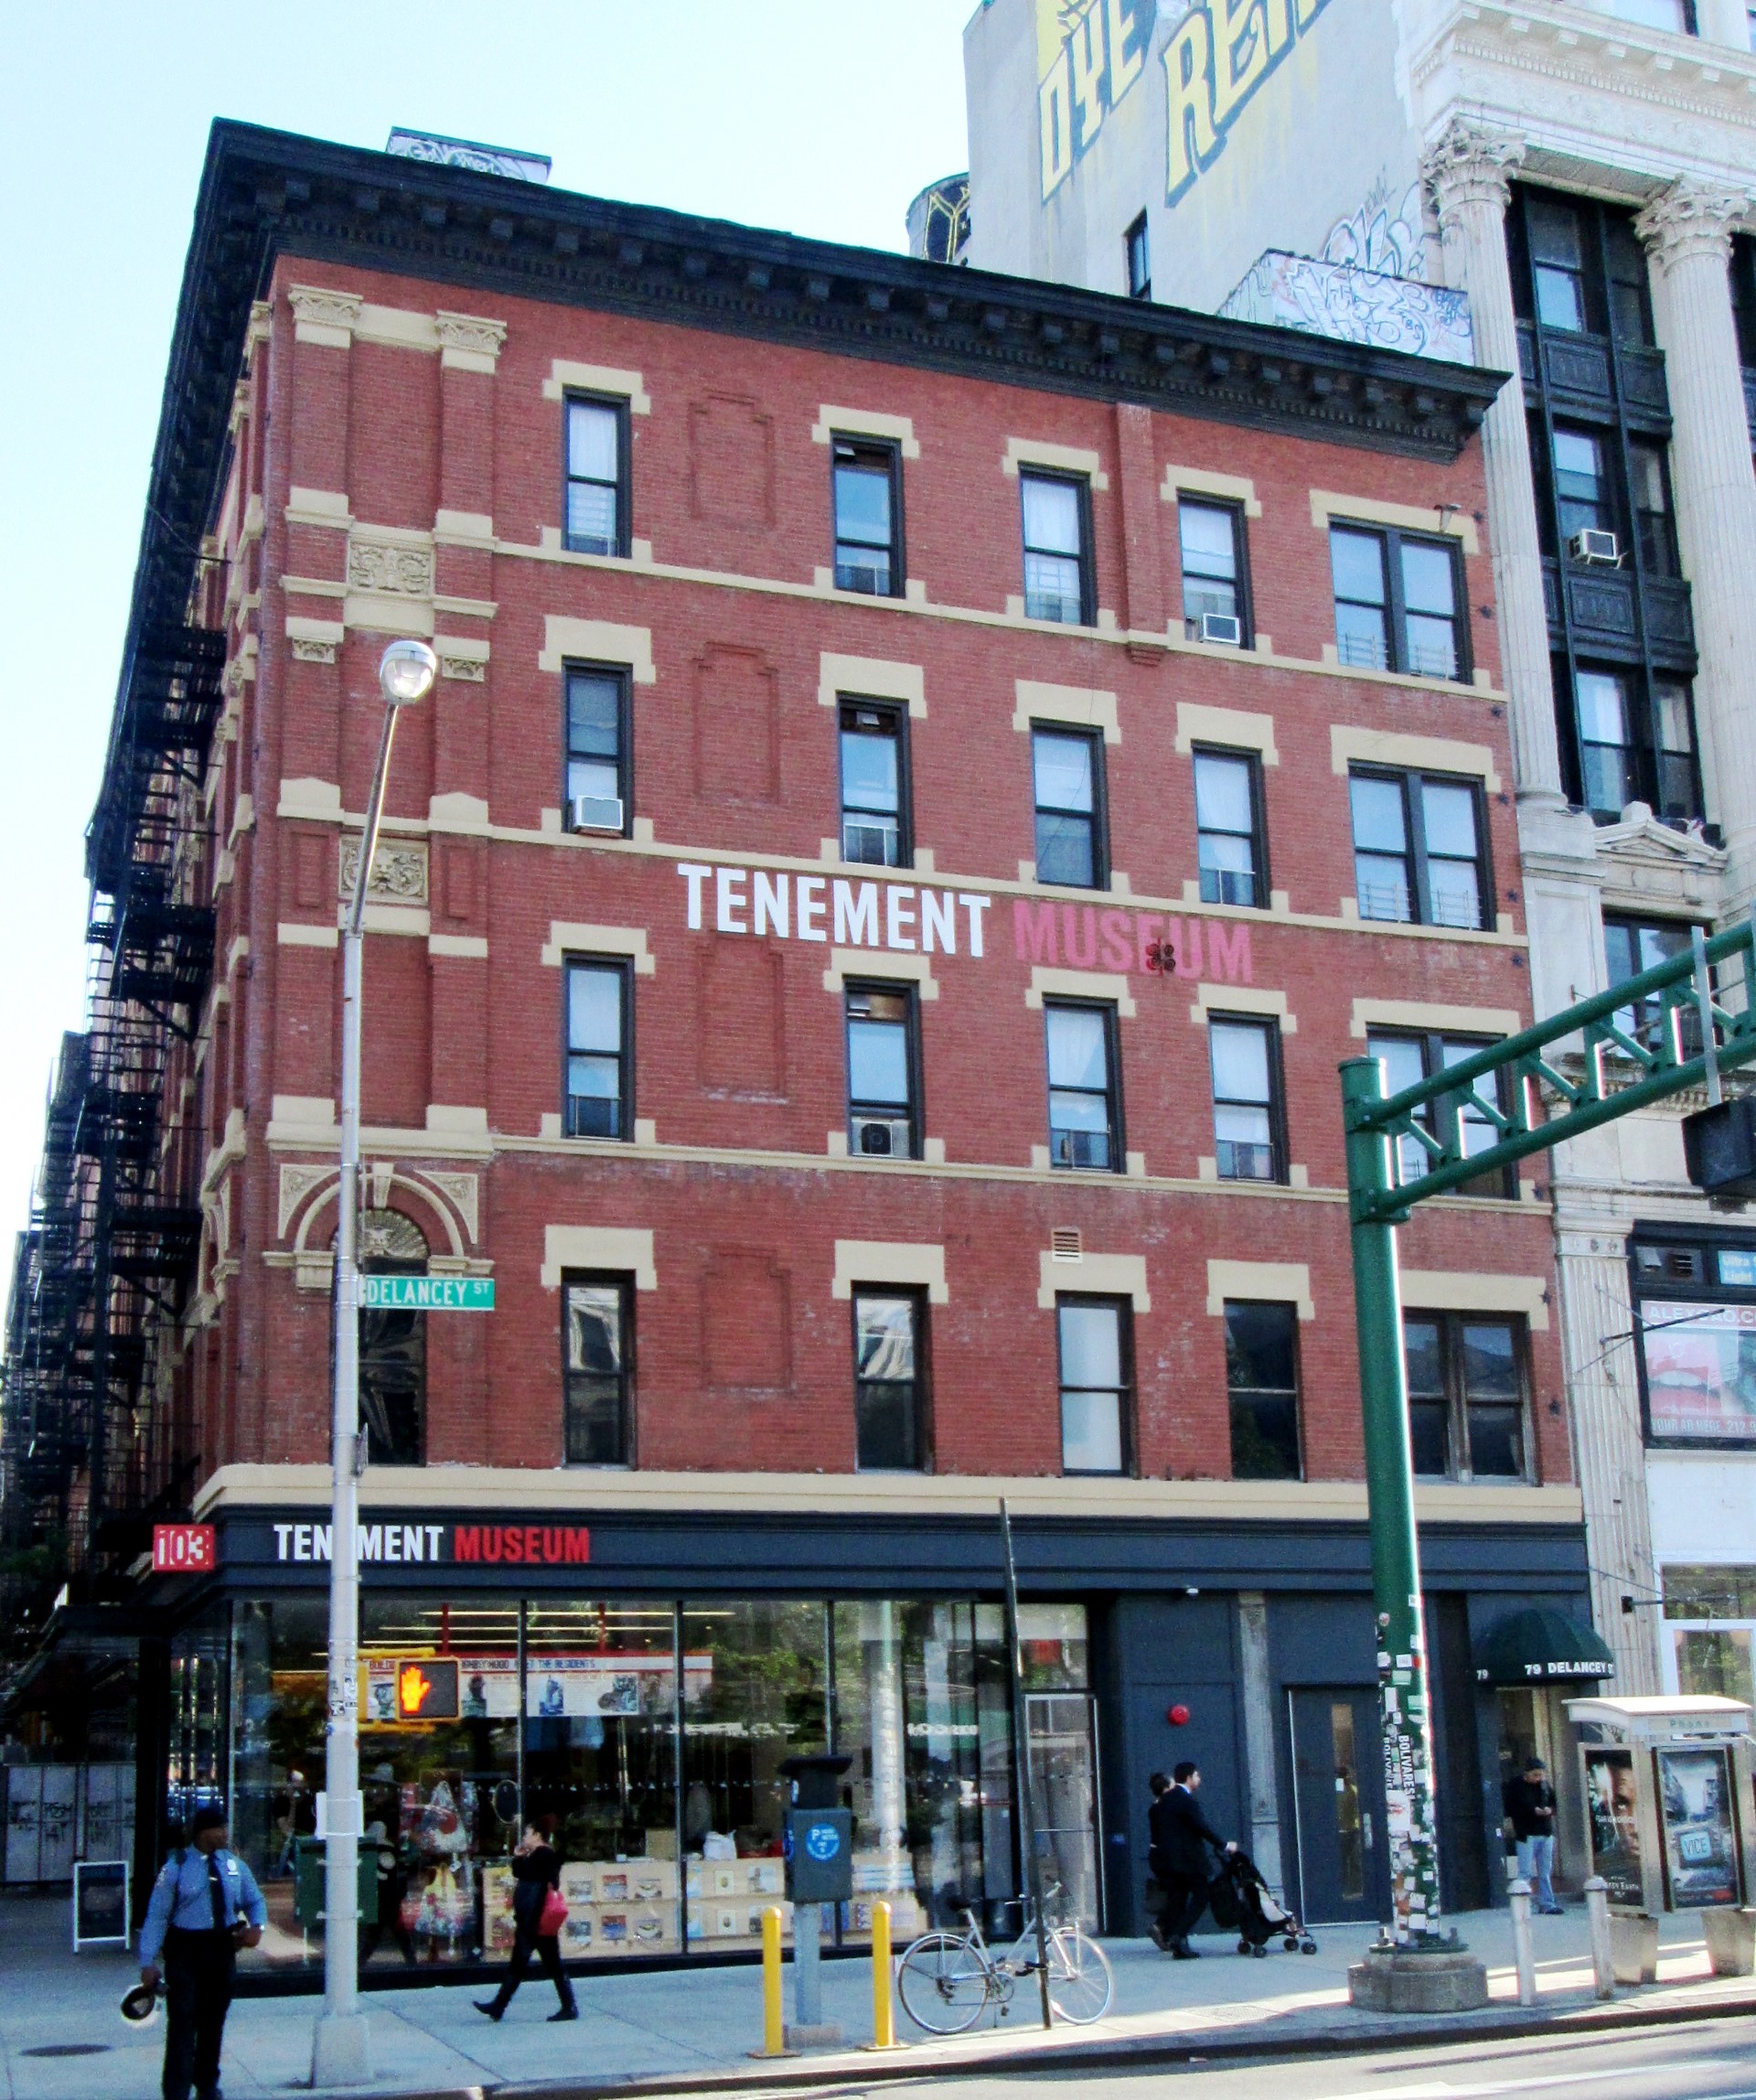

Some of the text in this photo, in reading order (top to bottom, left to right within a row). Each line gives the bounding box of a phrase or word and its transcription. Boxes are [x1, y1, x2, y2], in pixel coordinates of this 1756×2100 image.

[677, 862, 1254, 983] TENEMENT MUSEUM
[367, 1280, 490, 1305] DELANCEY ST
[158, 1529, 211, 1566] 103
[273, 1524, 591, 1563] TENMENT MUSEUM
[1476, 1669, 1489, 1680] 79
[1525, 1664, 1542, 1675] 79
[1547, 1662, 1606, 1673] DELANCEY
